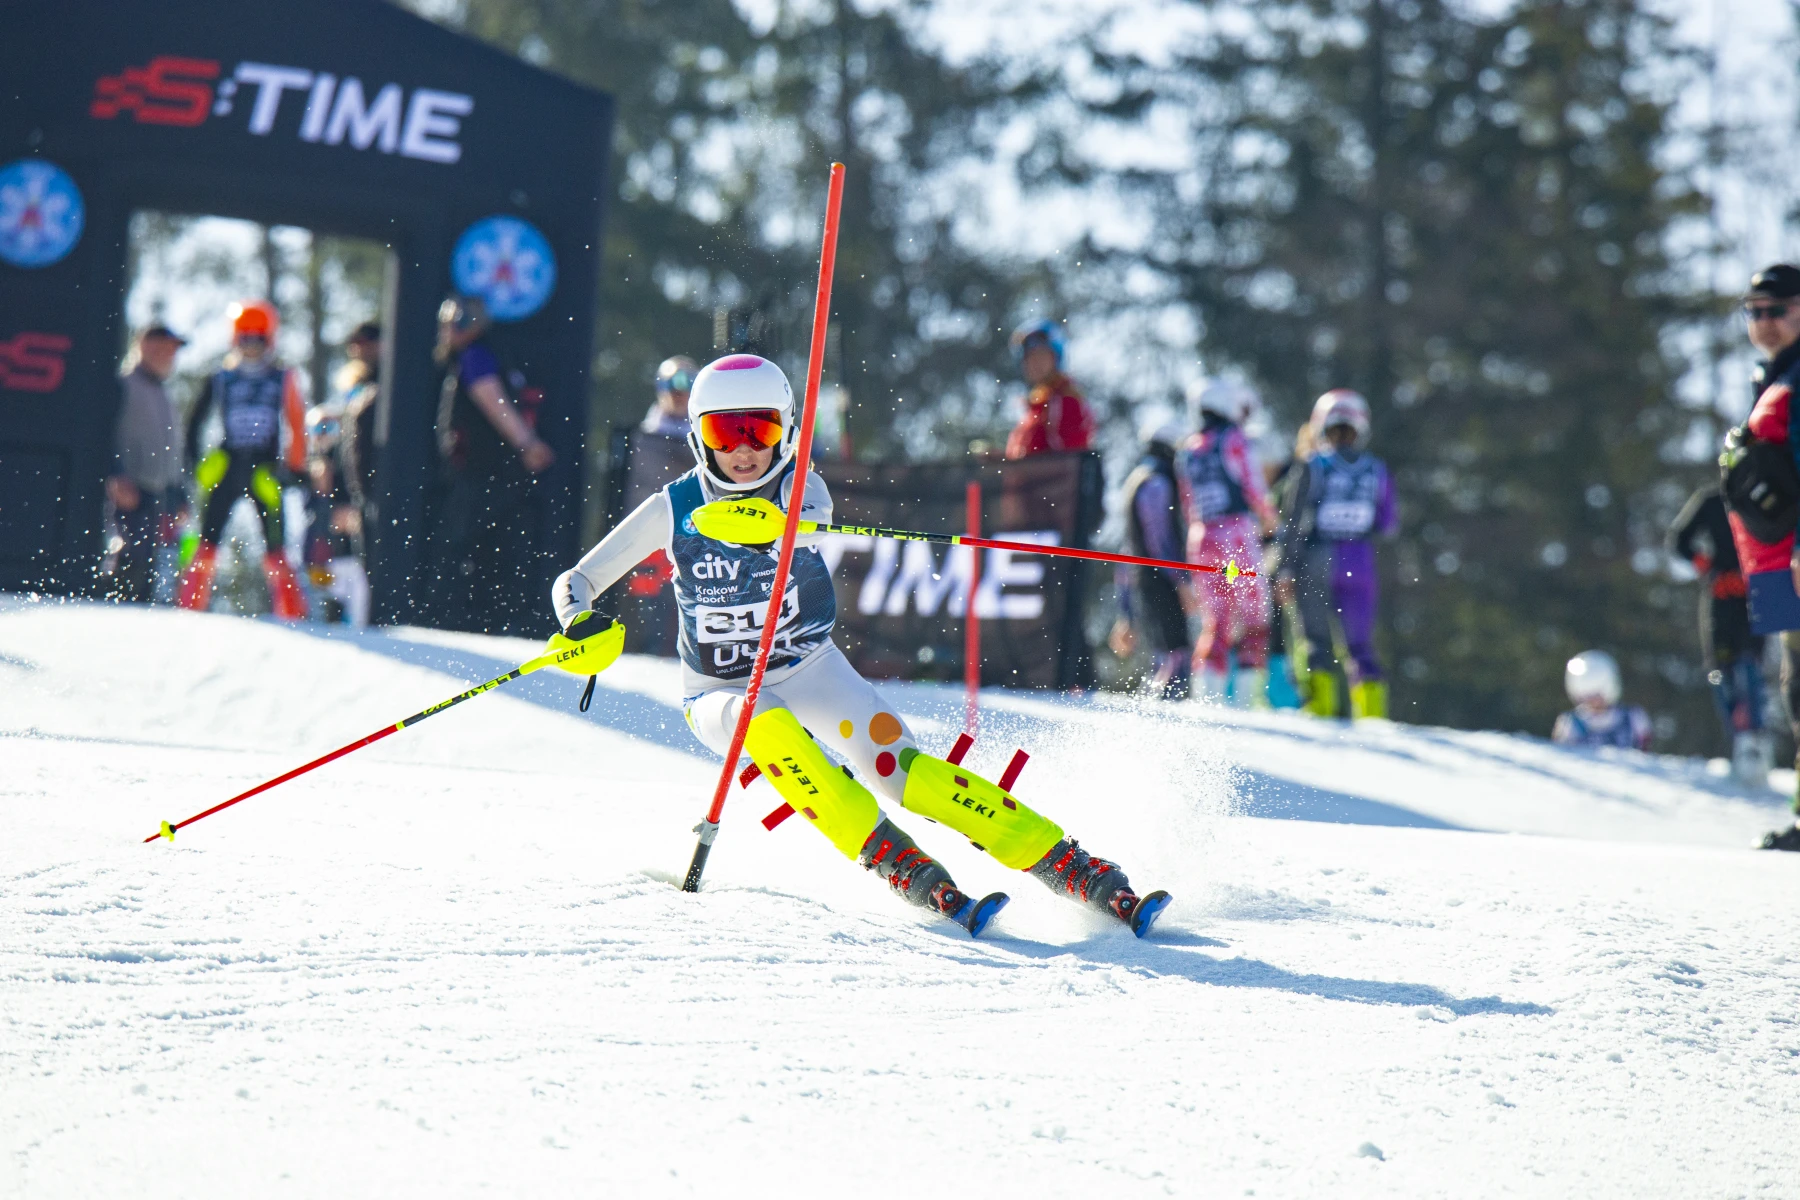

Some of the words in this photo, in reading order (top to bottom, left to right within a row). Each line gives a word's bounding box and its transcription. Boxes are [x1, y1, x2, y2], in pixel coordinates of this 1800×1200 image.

[826, 523, 876, 537] LEKI
[691, 553, 741, 580] city
[695, 585, 738, 597] Krakow
[696, 594, 726, 603] Sport
[556, 645, 585, 663] LEKI
[715, 663, 748, 675] UNLEASH
[468, 673, 513, 698] LEKI
[782, 756, 819, 795] LEKI
[951, 792, 996, 819] LEKI
